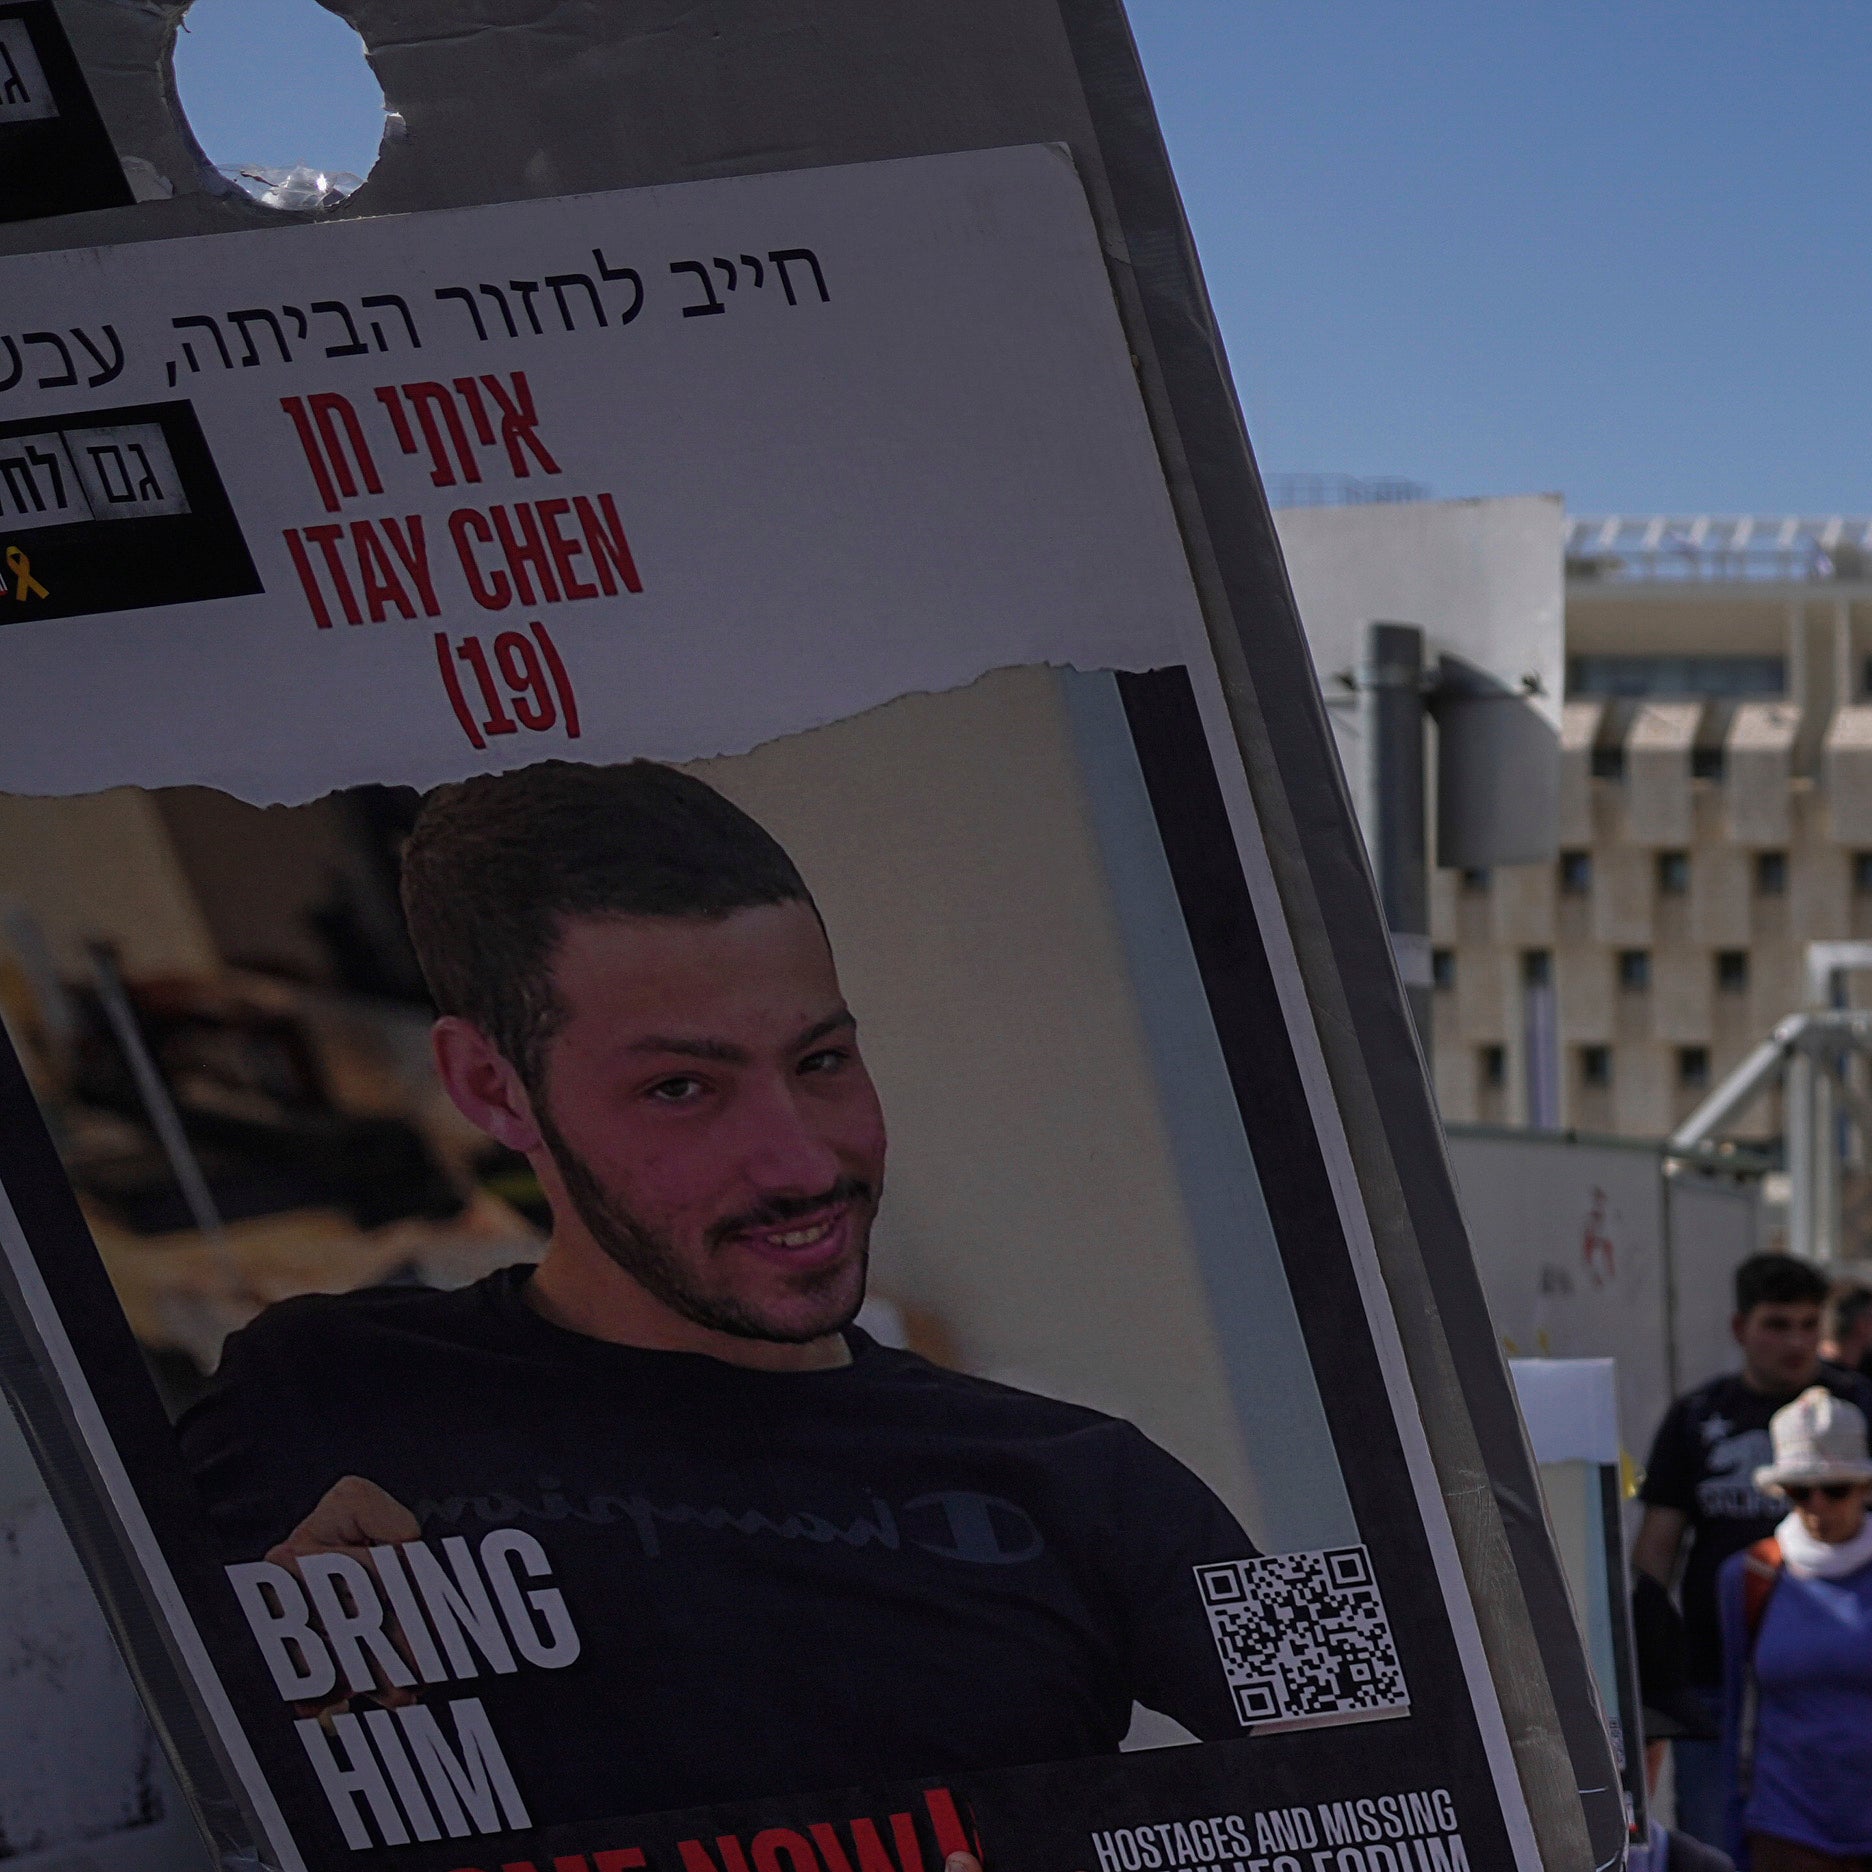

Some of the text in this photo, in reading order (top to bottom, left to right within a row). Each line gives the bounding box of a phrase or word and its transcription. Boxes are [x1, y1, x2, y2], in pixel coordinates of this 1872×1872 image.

[435, 248, 645, 342] לחזור
[669, 246, 831, 319] חייב
[164, 291, 422, 391] הביתה,
[86, 443, 164, 505] גם
[280, 370, 562, 512] איתי חן
[281, 492, 644, 631] ITAY CHEN
[434, 621, 581, 750] (19)
[224, 1528, 580, 1702] BRING
[293, 1697, 532, 1850] HIM
[1254, 1806, 1318, 1855] AND
[1318, 1788, 1459, 1847] MISSING
